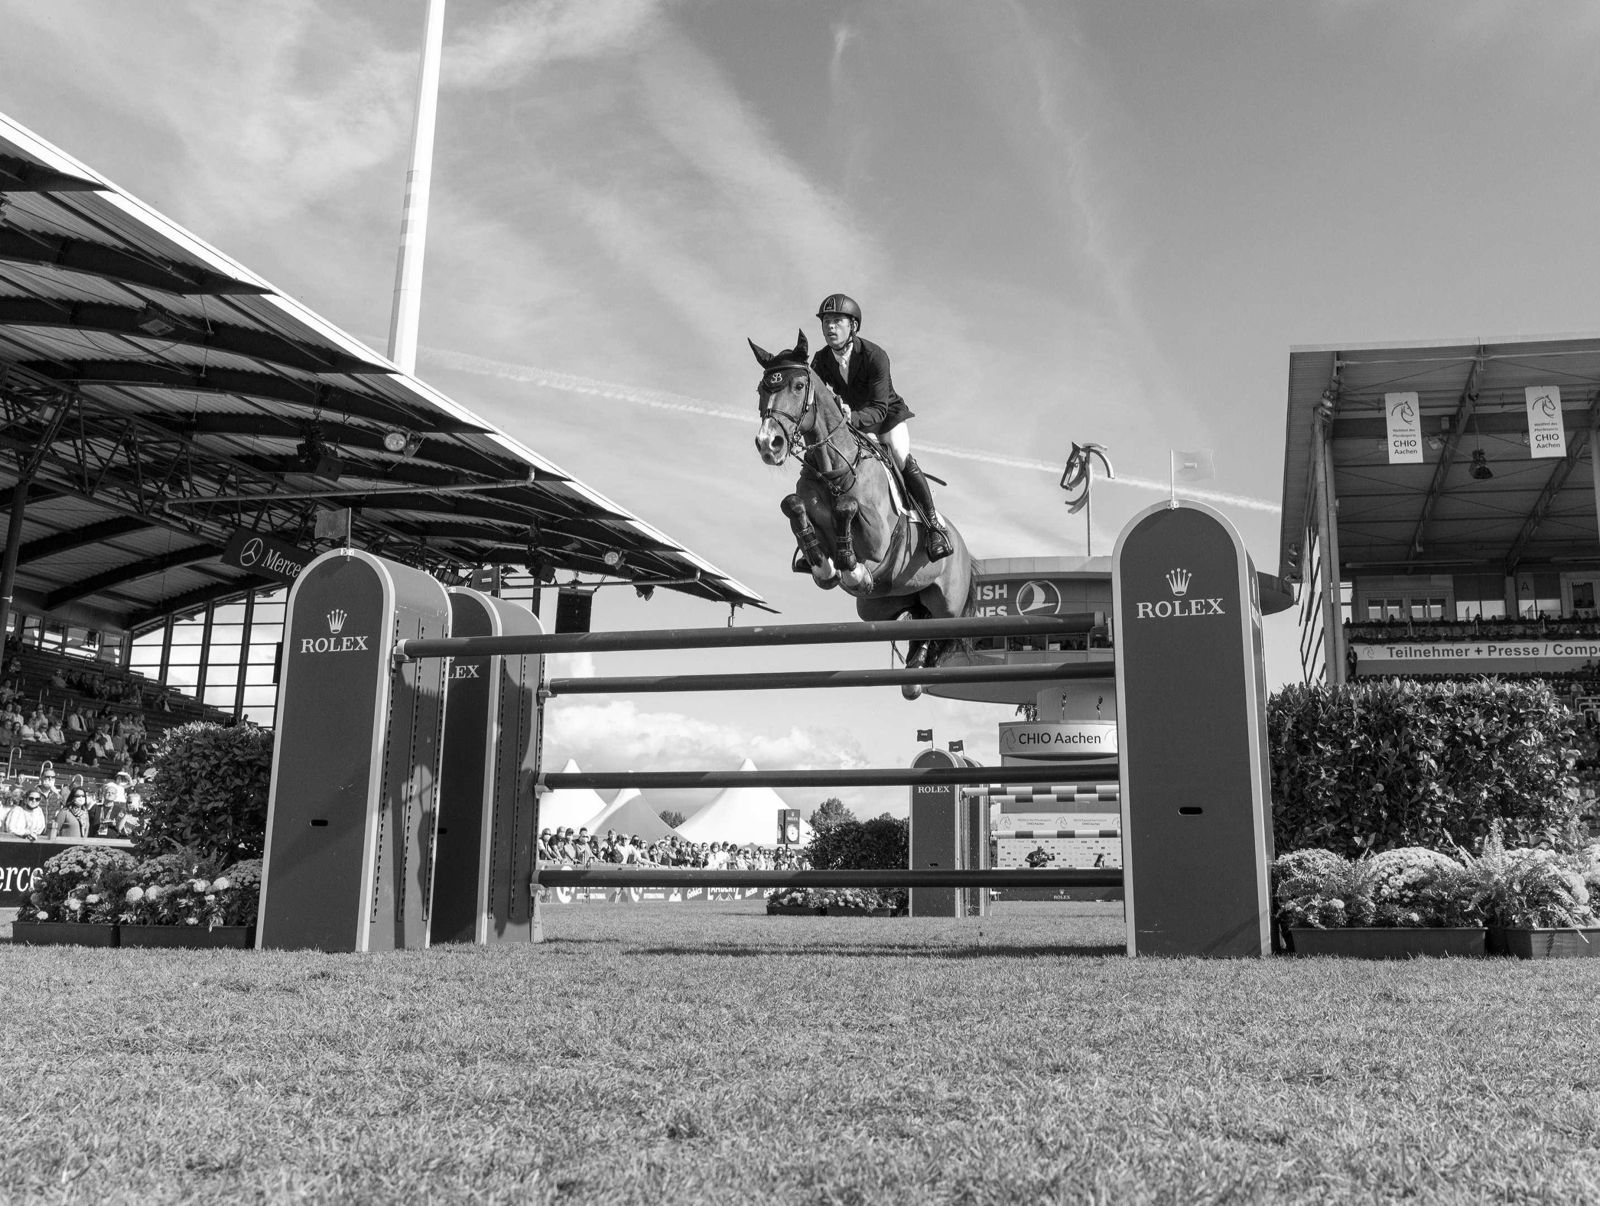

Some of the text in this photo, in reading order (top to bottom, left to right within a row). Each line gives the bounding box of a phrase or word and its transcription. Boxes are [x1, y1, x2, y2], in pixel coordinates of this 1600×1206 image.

[1393, 440, 1417, 448] CHIO
[1535, 433, 1560, 442] CHIO
[976, 583, 1008, 601] ISH
[1136, 598, 1226, 619] ROLEX
[300, 635, 369, 654] ROLEX
[1386, 645, 1470, 658] Teilnehmer
[1487, 644, 1540, 657] Presse
[1552, 643, 1600, 658] Comp
[1018, 732, 1101, 745] CHIO Aachen
[918, 785, 950, 794] ROLEX
